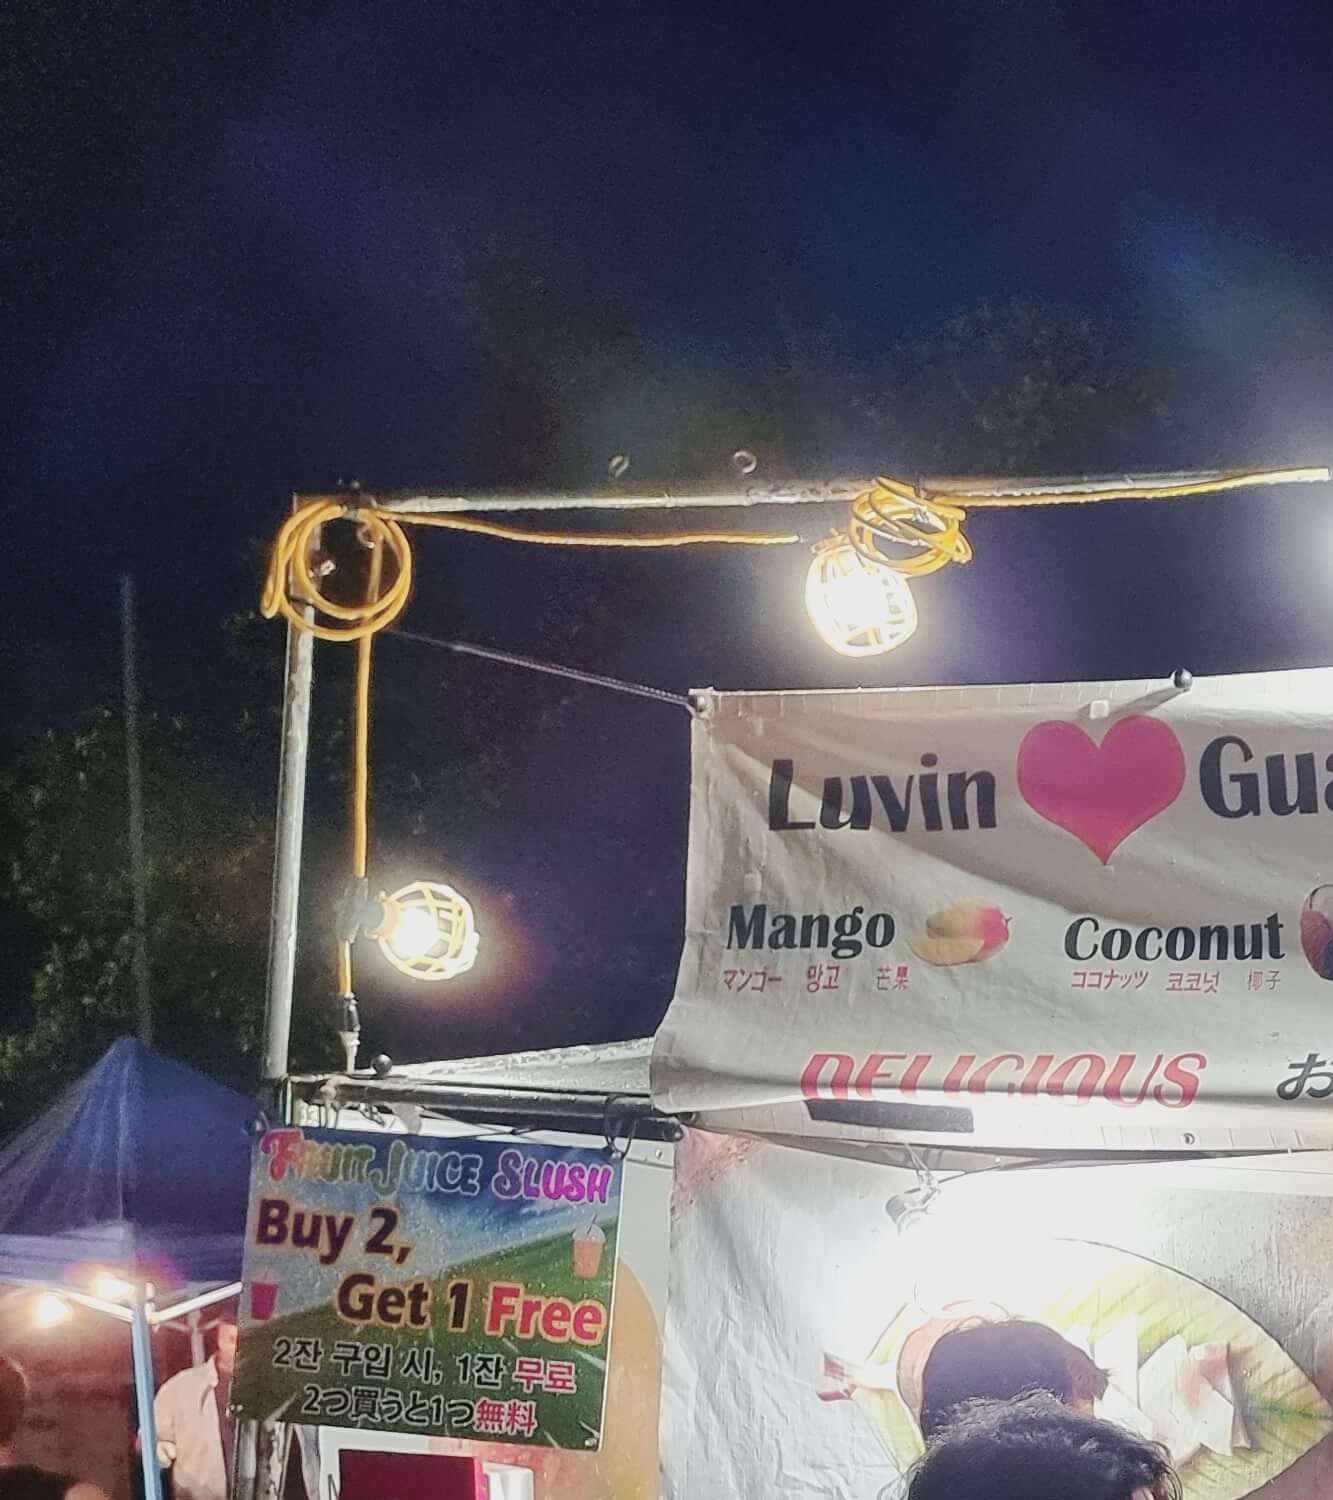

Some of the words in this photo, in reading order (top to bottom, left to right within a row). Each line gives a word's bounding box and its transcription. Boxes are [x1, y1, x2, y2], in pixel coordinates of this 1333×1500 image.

[768, 755, 998, 833] Luvin
[726, 904, 896, 960] Mango
[1064, 913, 1286, 961] Coconut
[723, 968, 783, 992] マンゴー
[806, 965, 840, 993] 망고
[876, 966, 909, 991] 芒果
[1071, 969, 1150, 990] ココナッツ
[1165, 970, 1221, 993] 코코넛
[256, 1199, 353, 1265] Buy
[365, 1207, 412, 1264] 2,
[338, 1273, 429, 1326] Get
[449, 1282, 469, 1328] 1
[488, 1285, 601, 1341] Free
[274, 1338, 322, 1371] 2잔
[332, 1343, 391, 1379] 구입
[403, 1347, 442, 1384] 시,
[457, 1354, 504, 1387] 1잔
[514, 1358, 577, 1393] 무료
[303, 1385, 538, 1435] 2つ買うと1つ無料
